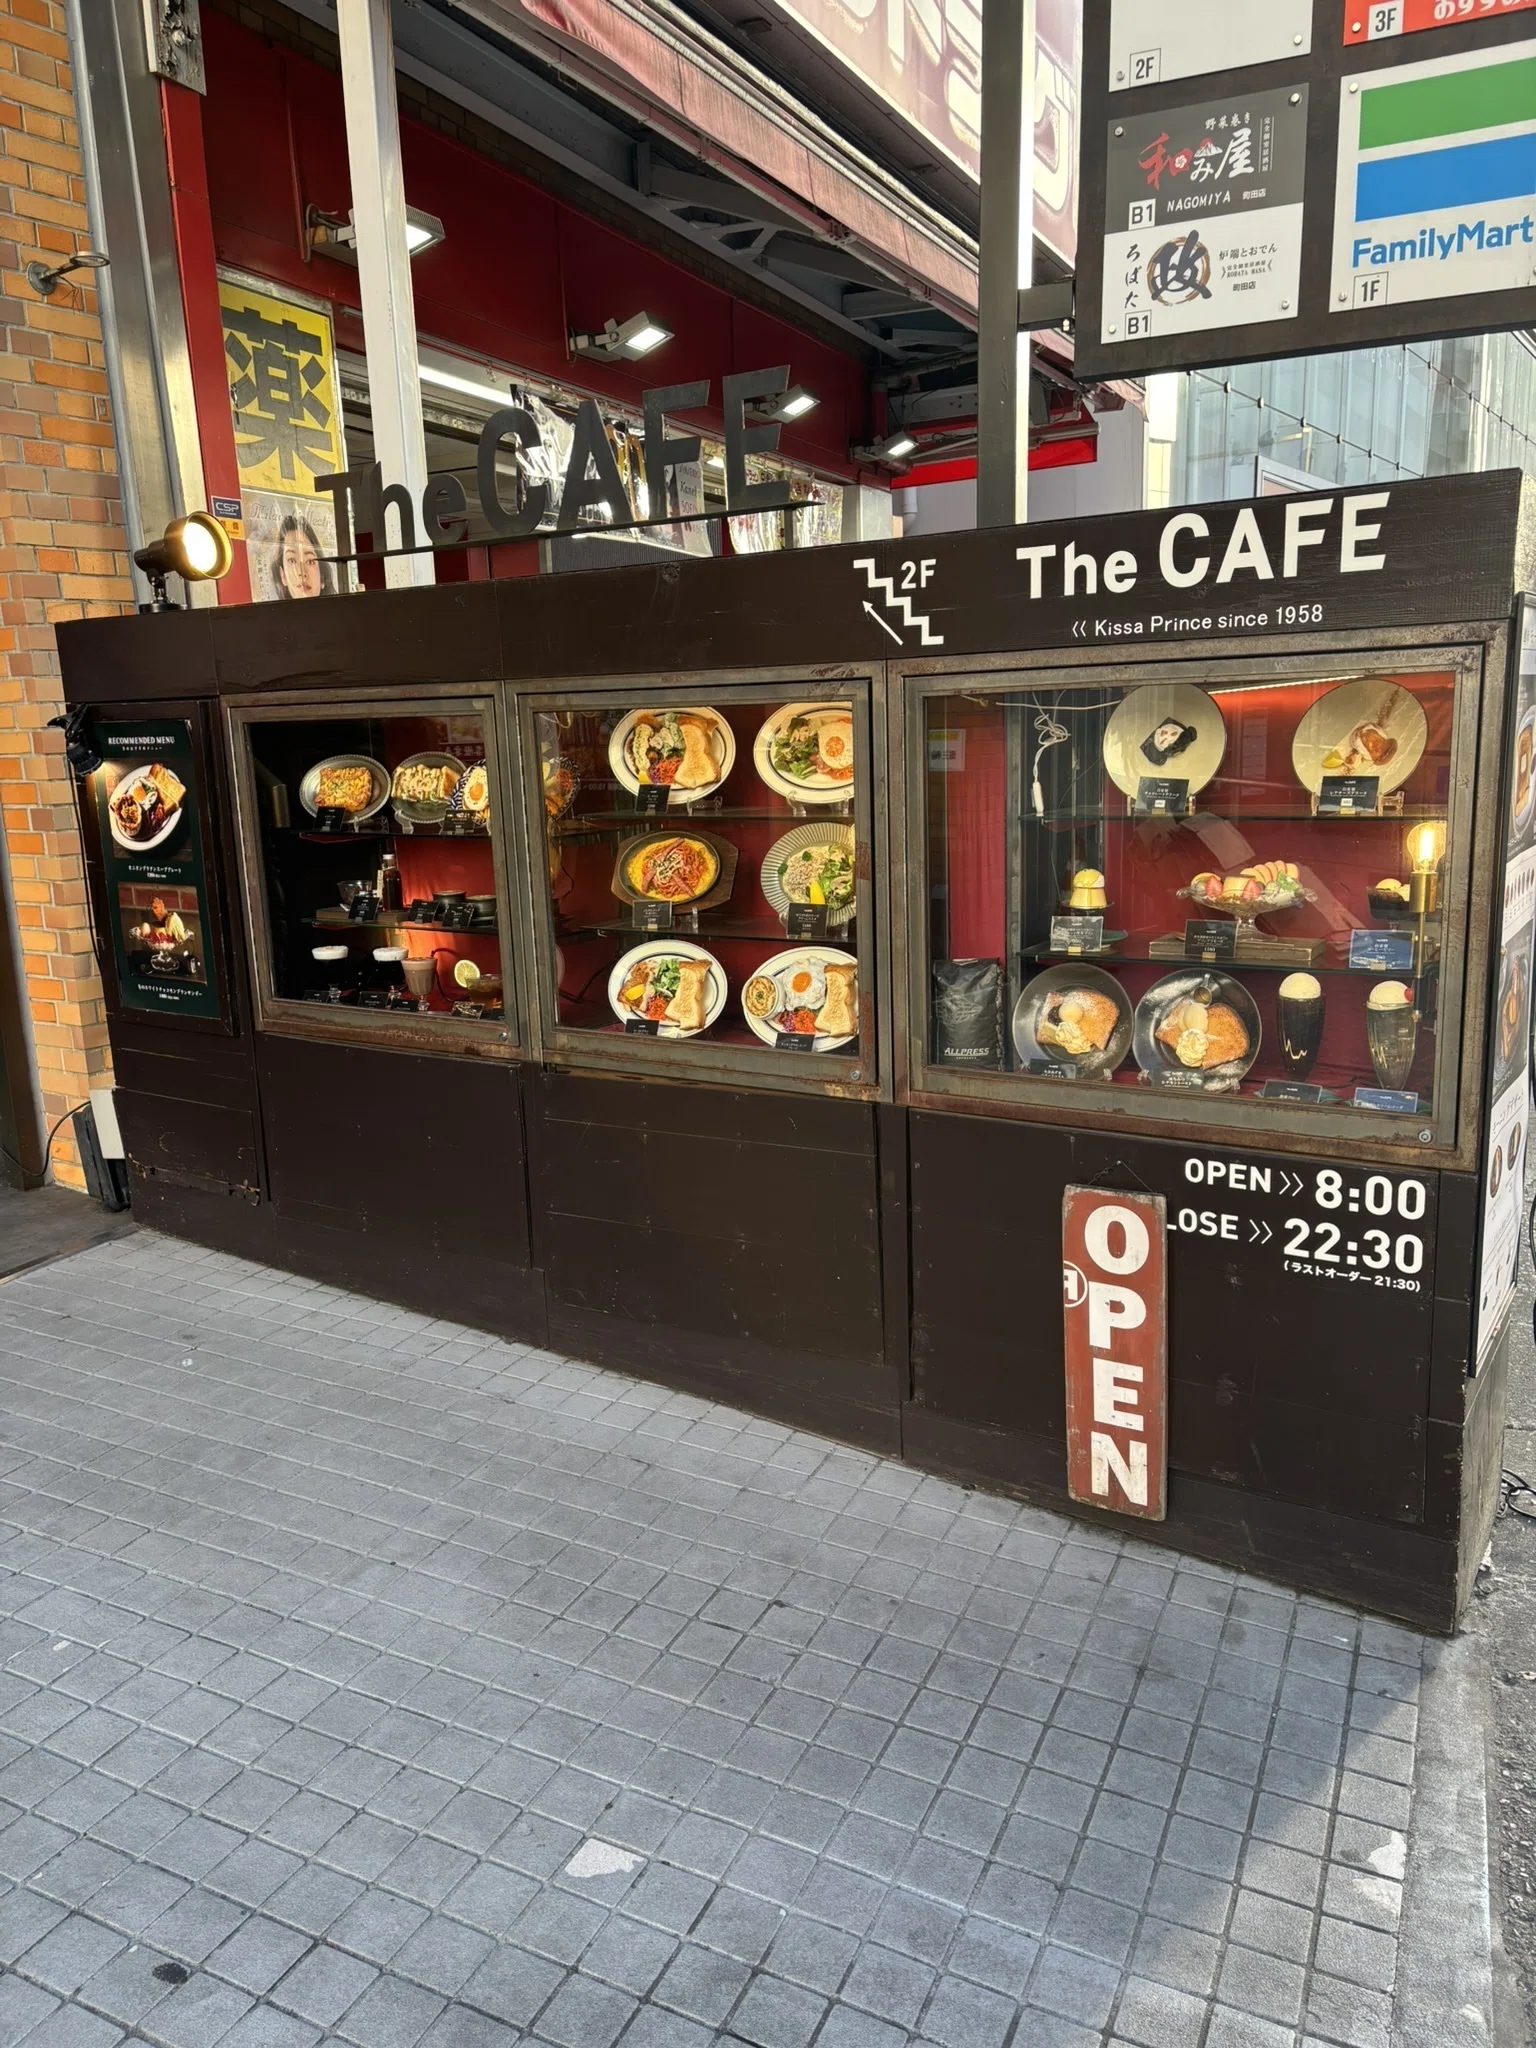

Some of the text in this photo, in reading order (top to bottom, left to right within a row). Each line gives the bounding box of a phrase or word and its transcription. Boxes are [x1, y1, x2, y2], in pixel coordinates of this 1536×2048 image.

[1375, 8, 1397, 33] 3F
[1135, 58, 1154, 80] 2F
[1167, 190, 1231, 213] NAGOMIYA
[1242, 188, 1267, 200] 町田店
[1131, 203, 1154, 225] B1
[1352, 215, 1534, 268] FamilyMart
[1124, 243, 1142, 309] ろばた
[1232, 281, 1256, 292] 町田店
[1361, 279, 1381, 302] 1F
[1127, 314, 1149, 335] B1
[220, 304, 336, 481] 薬
[314, 364, 791, 556] The CAFE
[215, 501, 240, 513] CSP
[1016, 491, 1391, 599] The CAFE
[901, 558, 937, 589] 2F
[1095, 604, 1323, 637] Kissa Prince since 1958
[156, 735, 175, 745] MENU
[943, 1047, 990, 1057] ALLPRESS
[1184, 1158, 1427, 1221] OPEN 8:00
[1283, 1217, 1425, 1275] 22:30
[1374, 1275, 1421, 1293] 21:30)
[1083, 1204, 1151, 1507] OPEN
